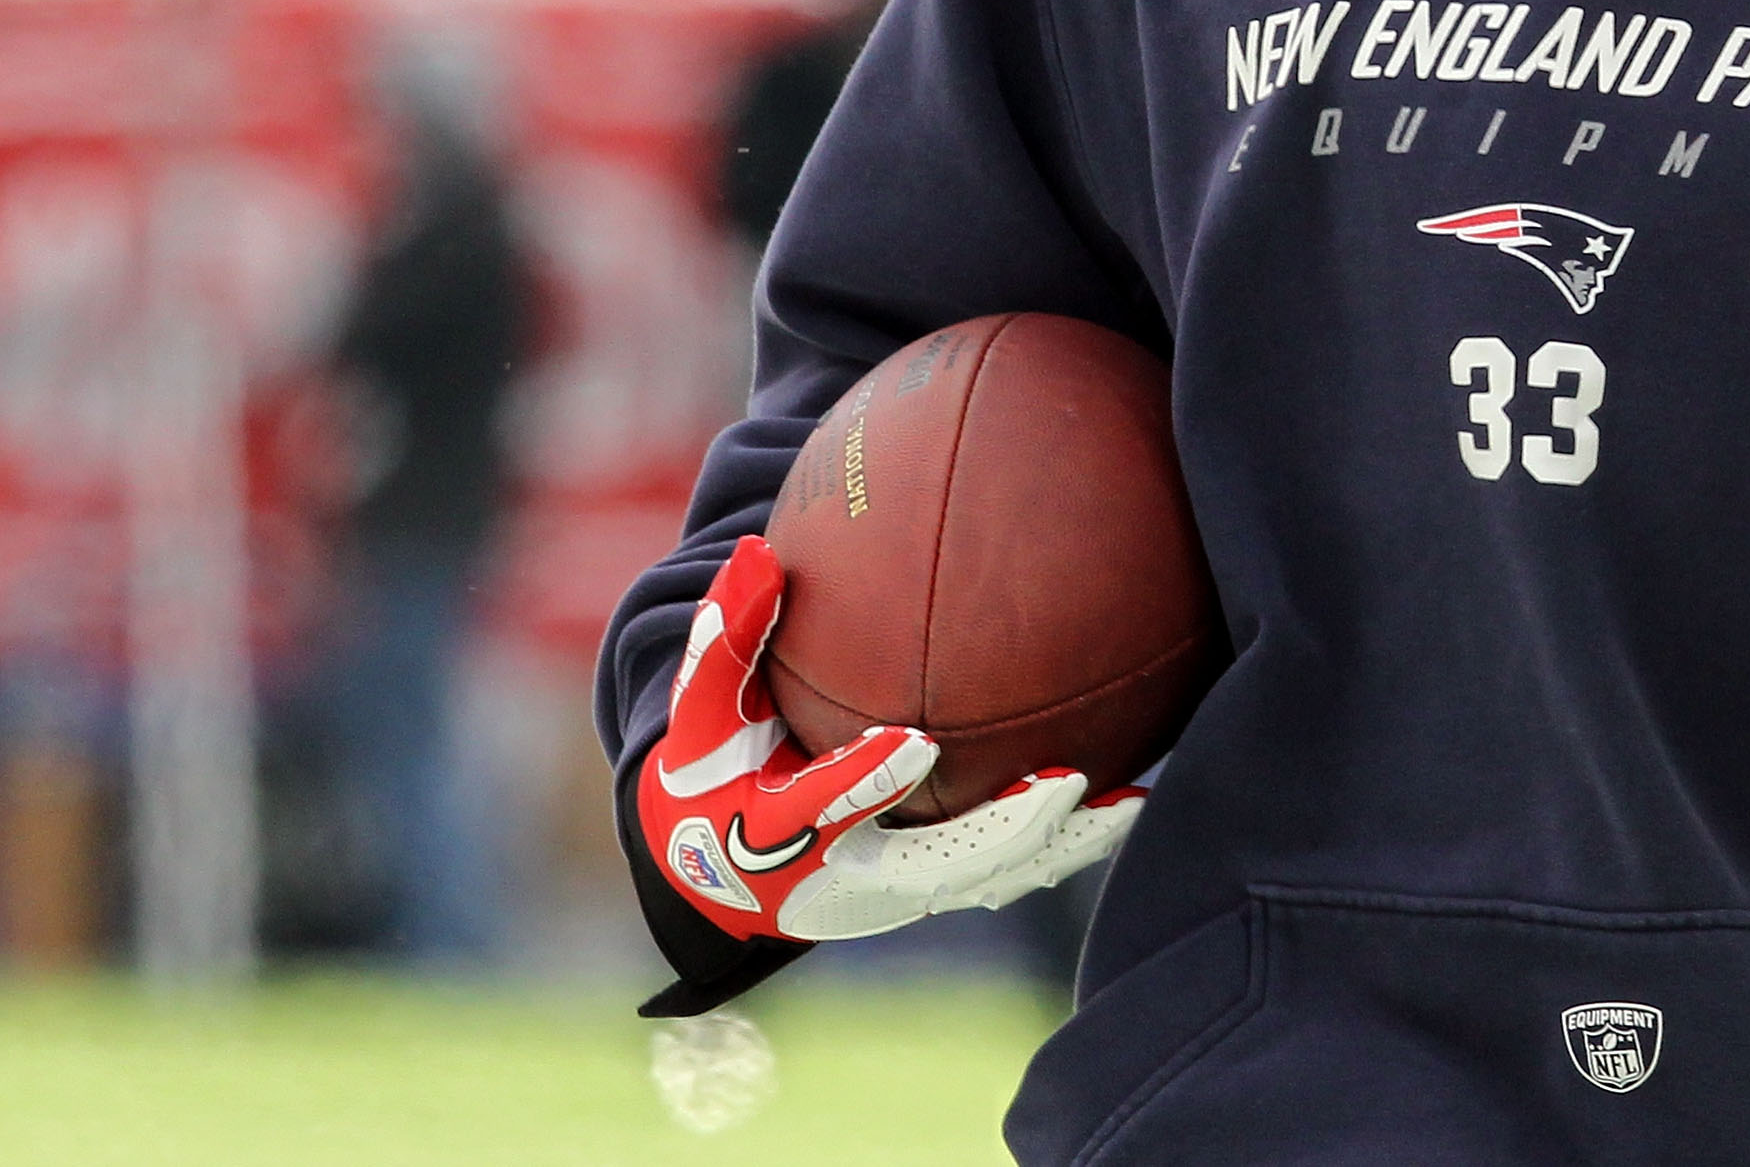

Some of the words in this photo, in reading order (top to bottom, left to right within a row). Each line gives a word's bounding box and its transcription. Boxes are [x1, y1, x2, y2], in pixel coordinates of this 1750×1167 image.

[1226, 0, 1351, 113] NEW
[1449, 336, 1607, 486] 33
[845, 416, 869, 519] NATIONAL
[681, 848, 711, 884] NFL
[1568, 1009, 1655, 1030] EQUIPMENT
[1595, 1053, 1636, 1078] NFL
